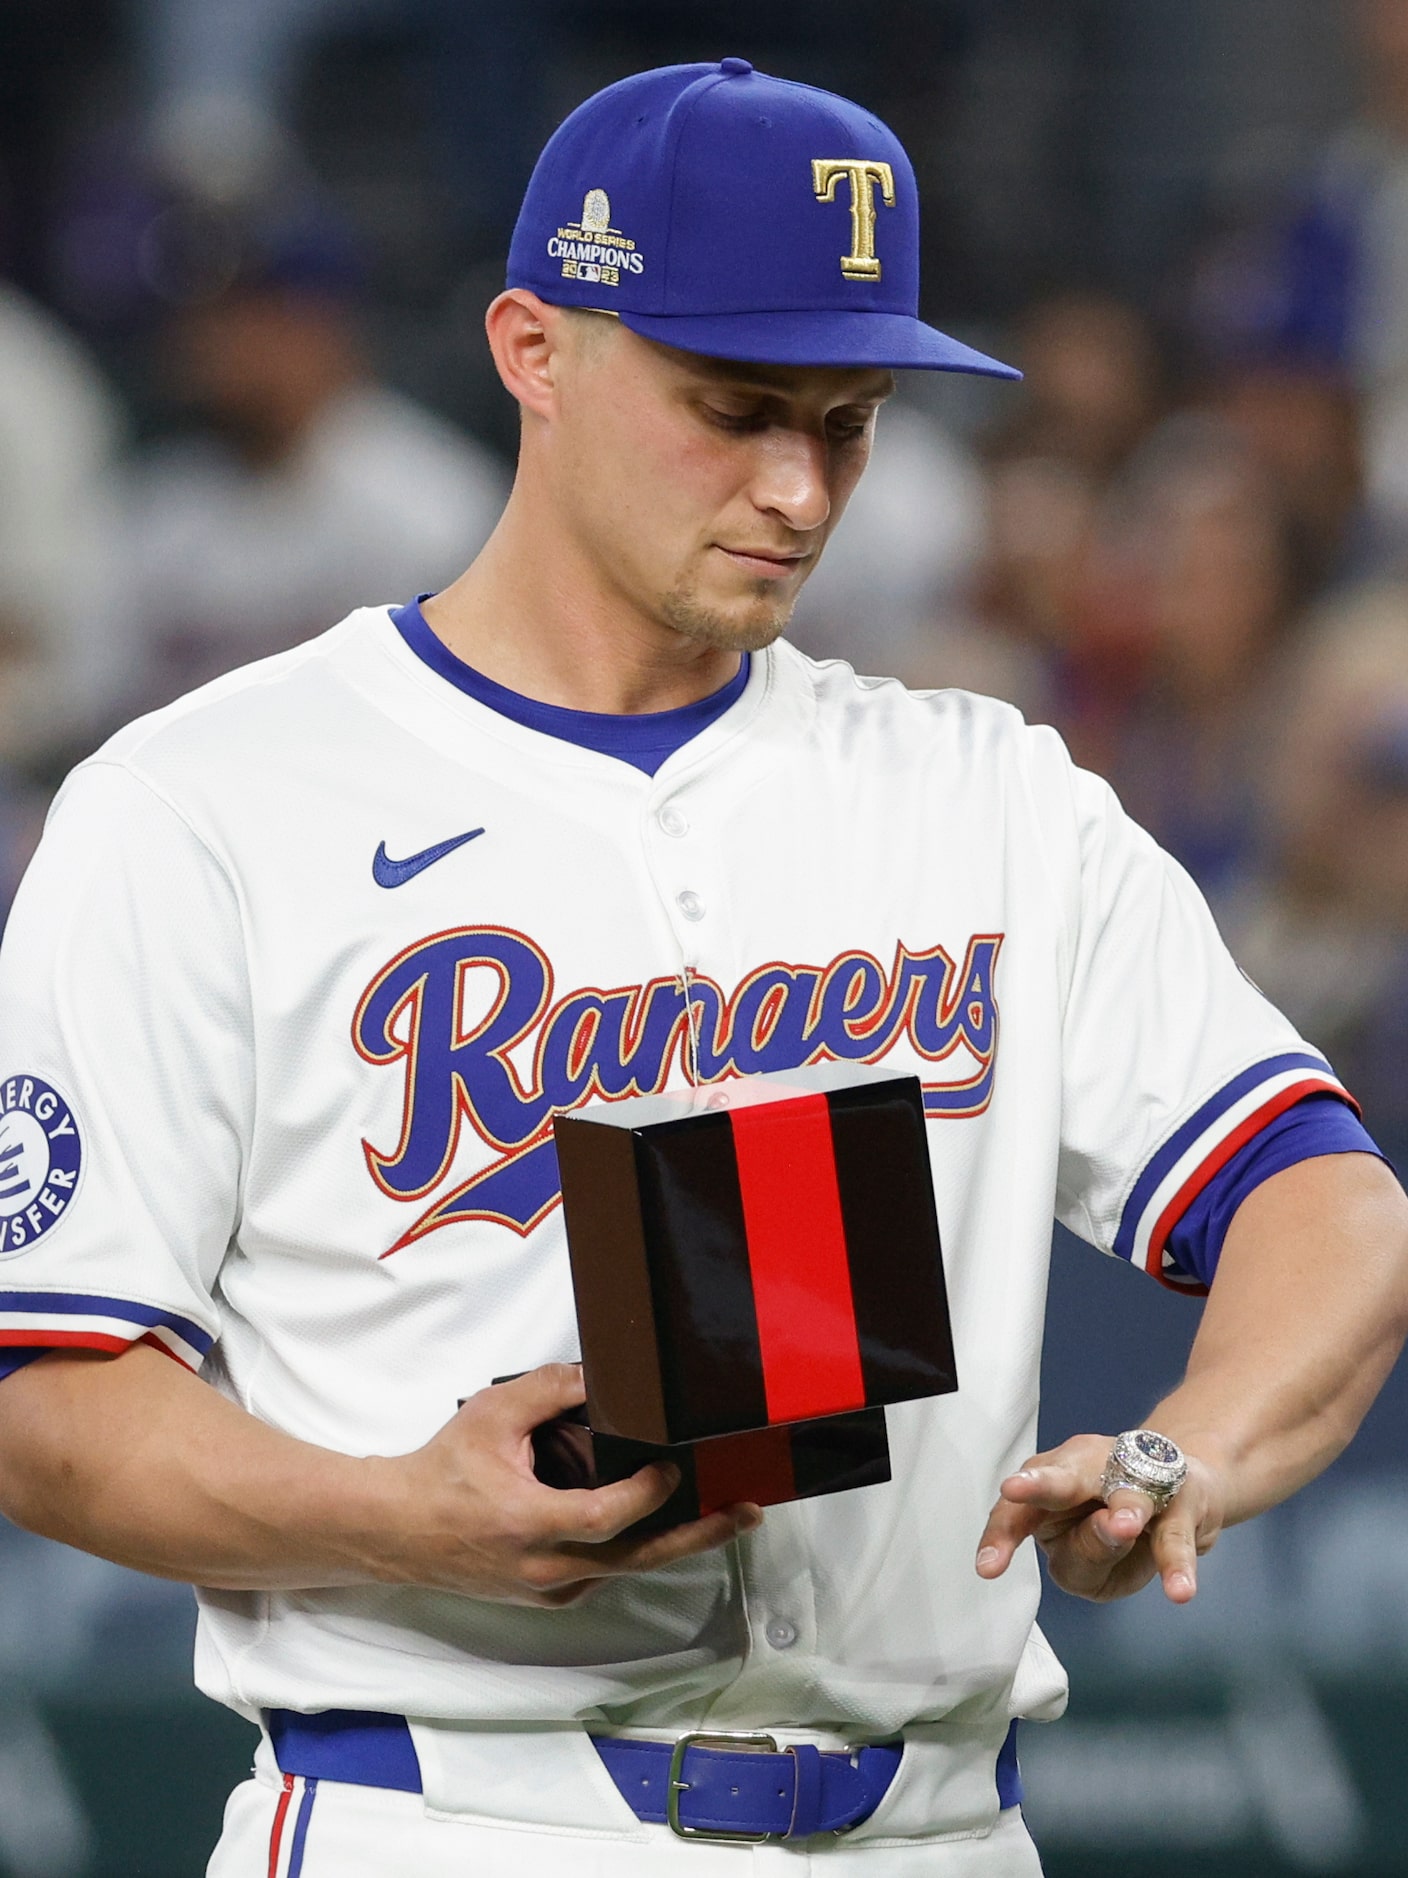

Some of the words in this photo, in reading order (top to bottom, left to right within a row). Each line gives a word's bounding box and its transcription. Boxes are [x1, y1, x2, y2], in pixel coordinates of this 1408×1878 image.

[557, 228, 593, 244] WORLD
[594, 234, 636, 251] SERIES
[811, 159, 896, 282] T
[547, 237, 645, 275] CHAMPIONS
[562, 263, 577, 275] 20
[602, 270, 620, 283] 23
[351, 924, 1006, 1202] Rangers
[0, 1078, 76, 1140] ERGY
